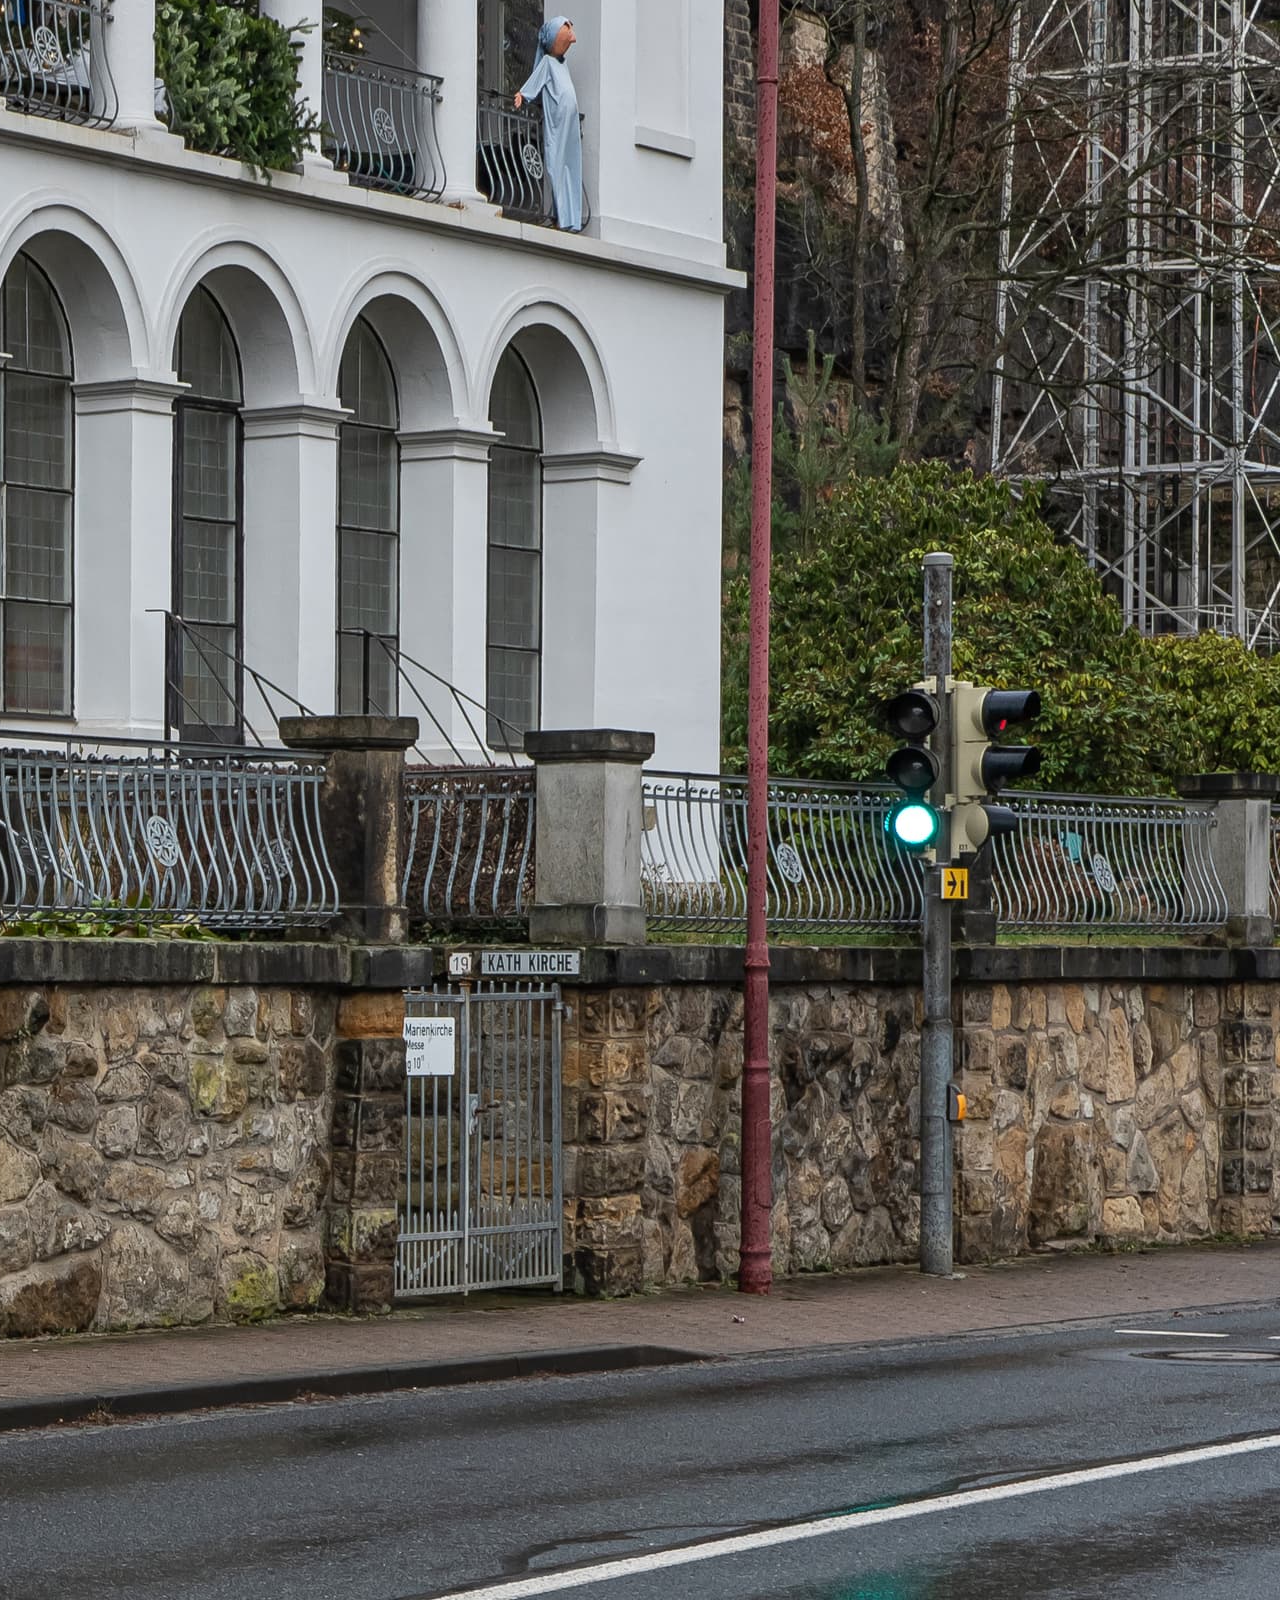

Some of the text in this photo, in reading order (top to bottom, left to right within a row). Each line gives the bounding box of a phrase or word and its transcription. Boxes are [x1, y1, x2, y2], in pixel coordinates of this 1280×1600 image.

[453, 956, 469, 971] 19
[488, 954, 573, 972] KATH KIRCHE
[405, 1023, 453, 1037] Marienkirche
